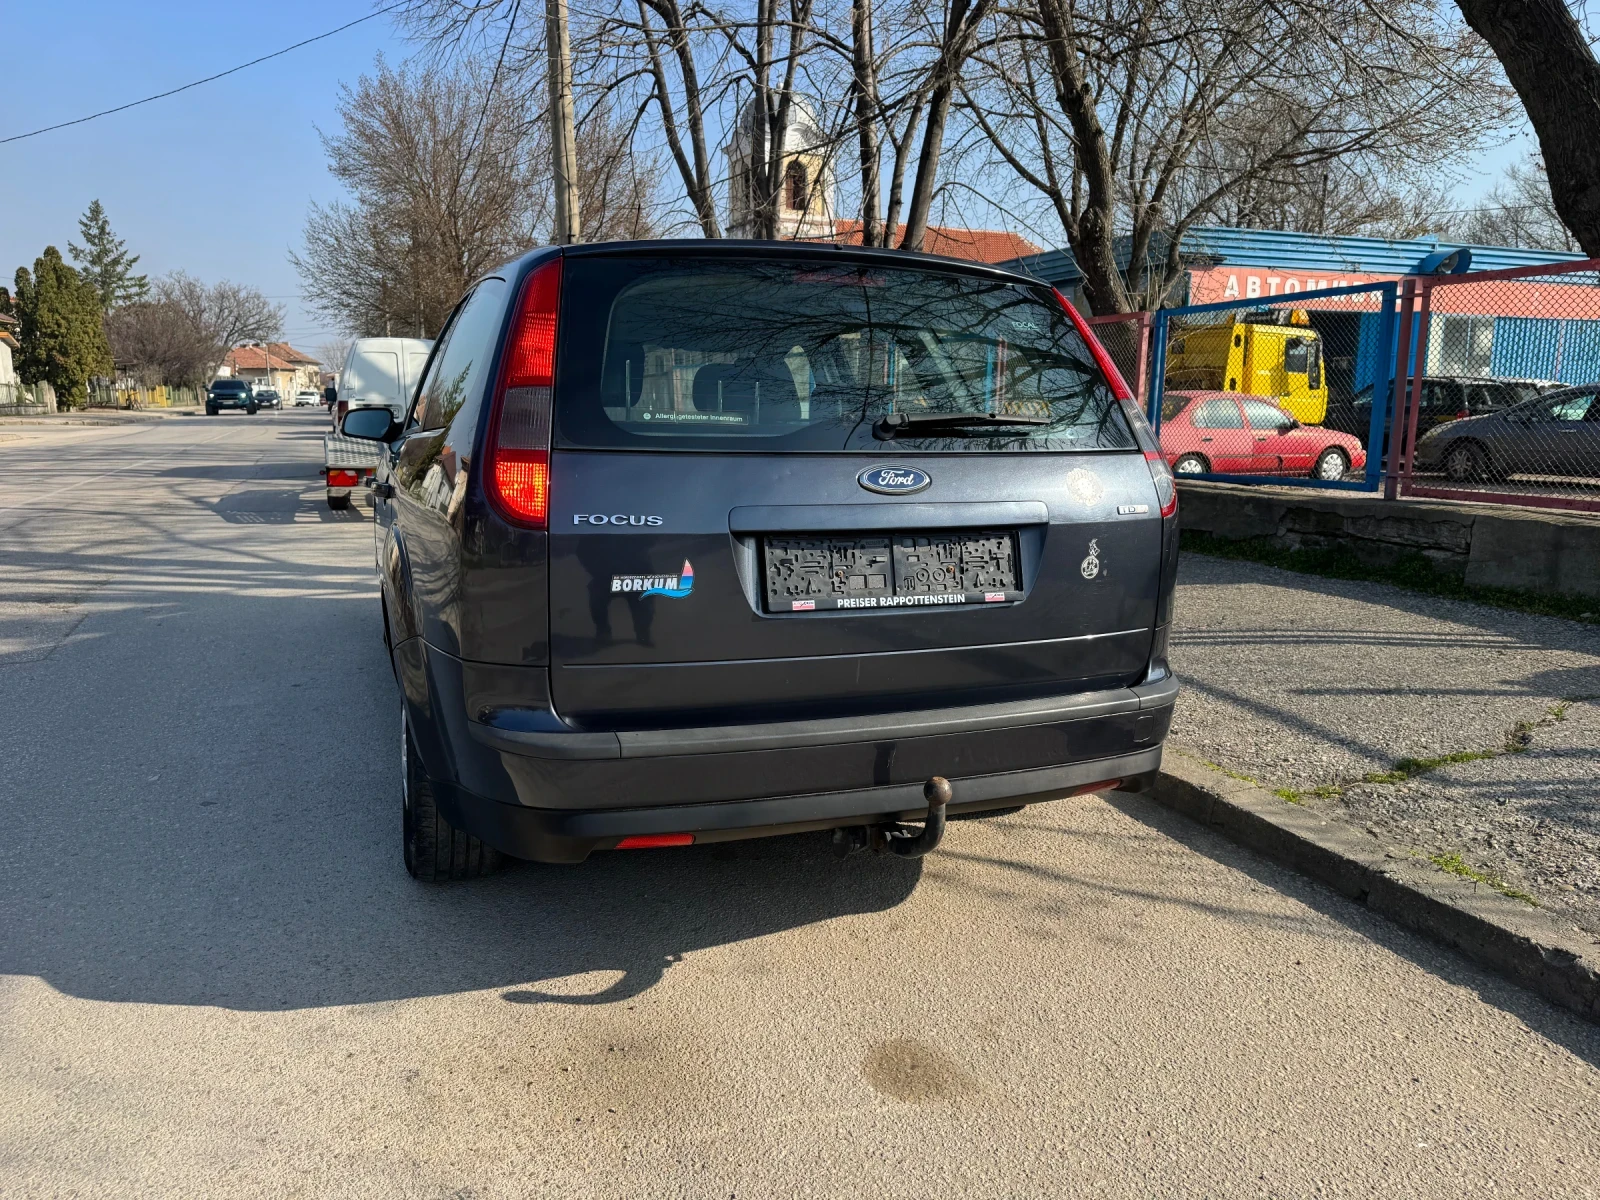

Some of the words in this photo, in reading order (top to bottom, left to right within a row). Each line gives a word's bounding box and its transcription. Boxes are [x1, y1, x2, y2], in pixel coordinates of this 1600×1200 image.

[710, 414, 743, 422] Innenraum
[878, 470, 914, 485] Ford
[573, 514, 663, 526] FOCUS
[611, 578, 678, 592] BORKUM
[837, 598, 877, 608] PREISER
[880, 594, 966, 606] RAPPOTTENSTEIN
